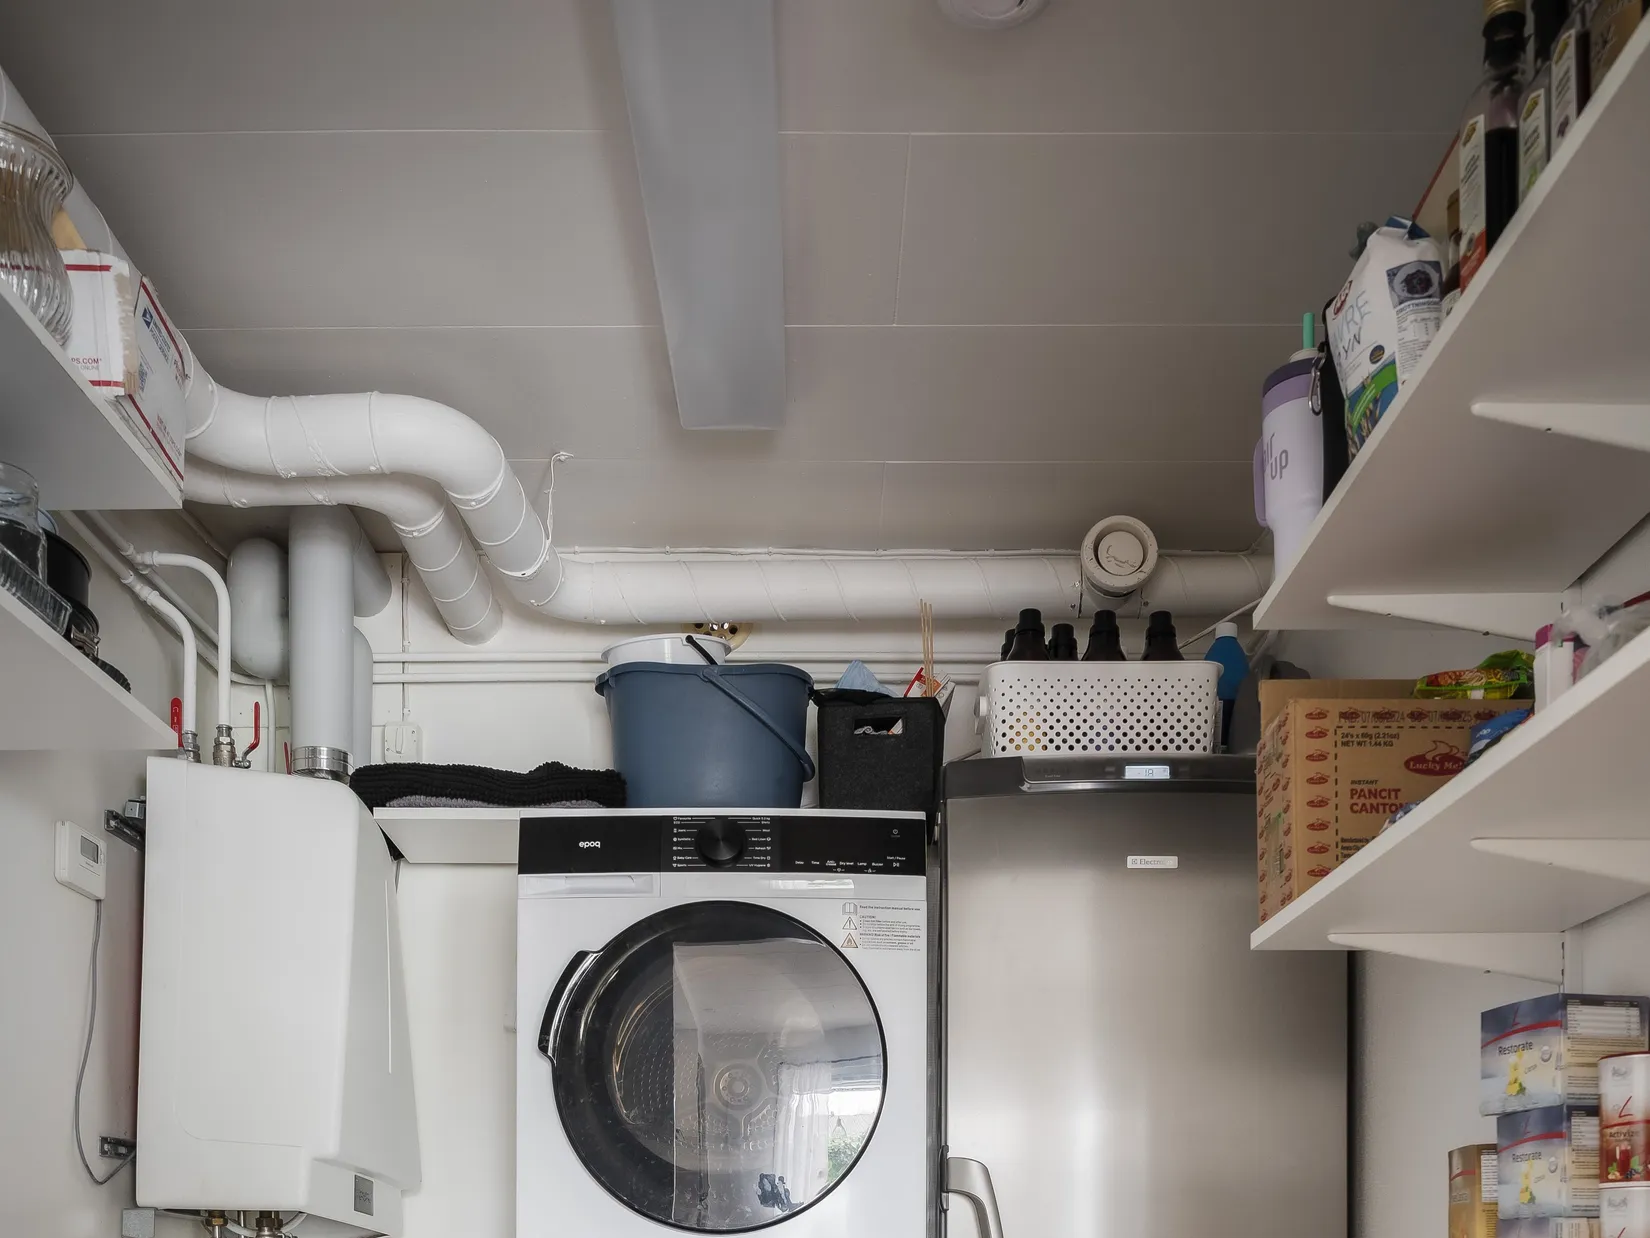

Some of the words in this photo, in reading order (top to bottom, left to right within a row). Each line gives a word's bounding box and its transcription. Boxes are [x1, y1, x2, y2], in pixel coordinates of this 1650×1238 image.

[1409, 760, 1440, 771] Lucky
[1350, 788, 1401, 800] PANCIT
[578, 841, 601, 849] epoq
[1497, 1041, 1534, 1056] Restorate
